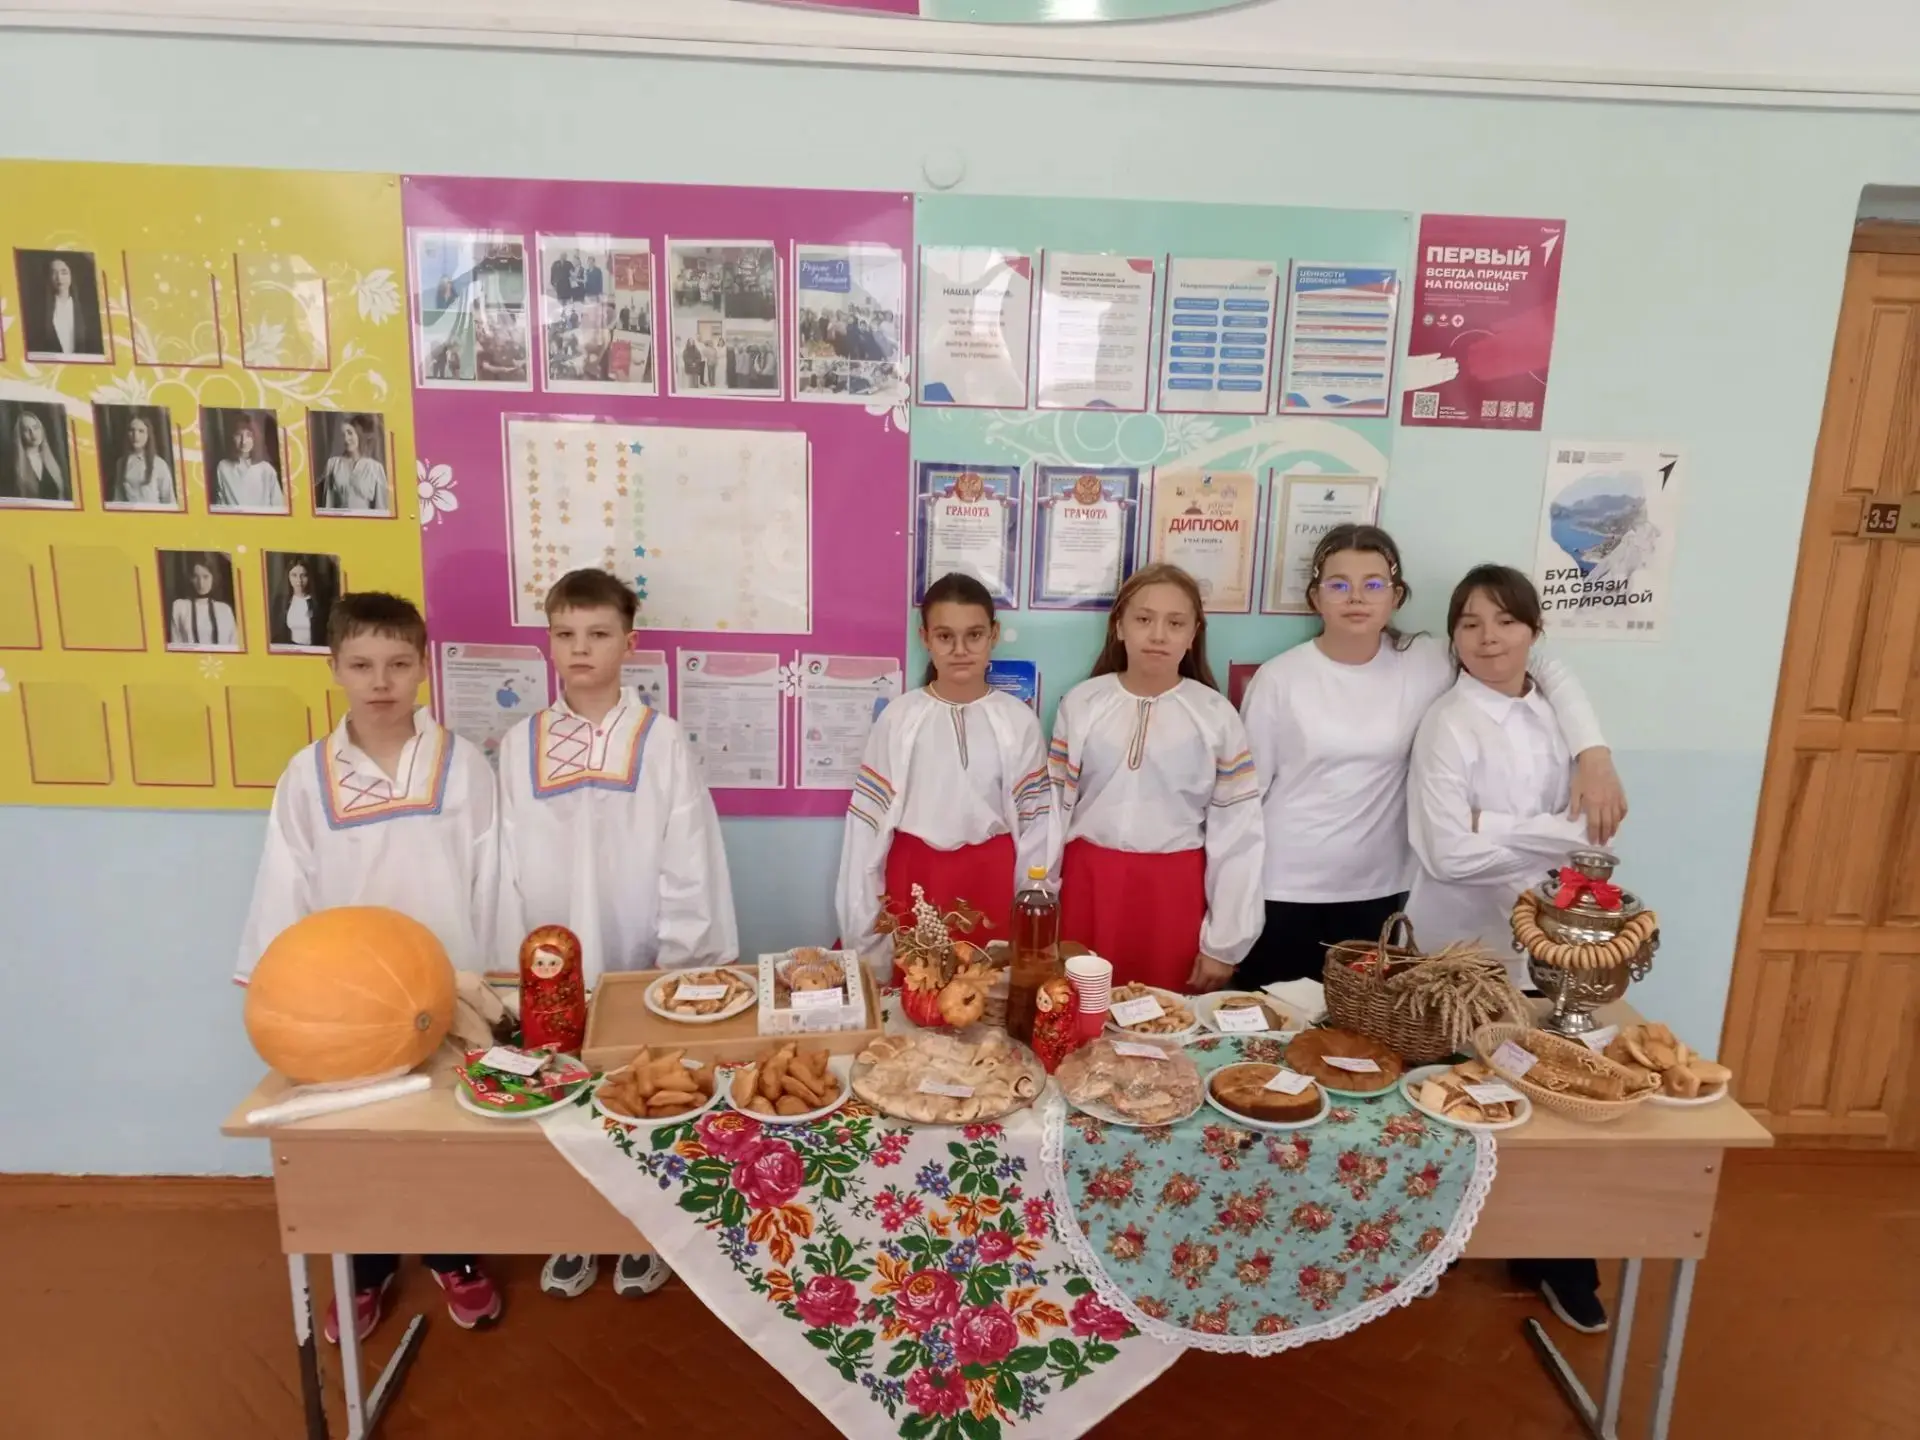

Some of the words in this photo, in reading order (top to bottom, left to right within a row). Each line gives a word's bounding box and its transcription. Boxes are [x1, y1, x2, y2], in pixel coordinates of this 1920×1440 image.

[1426, 245, 1531, 266] ПЕРВЫЙ
[1426, 268, 1474, 279] ВСЕГДА
[1477, 269, 1528, 281] ПРИДЕТ
[943, 288, 971, 296] НАША
[1425, 279, 1442, 289] НА
[1444, 280, 1509, 292] ПОМОЩЬ!
[945, 505, 990, 518] ГРАМОТА
[1064, 507, 1108, 520] ГРАМОТА
[1168, 518, 1239, 534] ДИПЛОМ
[1545, 567, 1590, 581] БУДЬ
[1543, 582, 1567, 596] НА
[1571, 579, 1629, 594] СВЯЗИ
[1541, 600, 1553, 611] С
[1556, 589, 1653, 610] ПРИРОДОЙ
